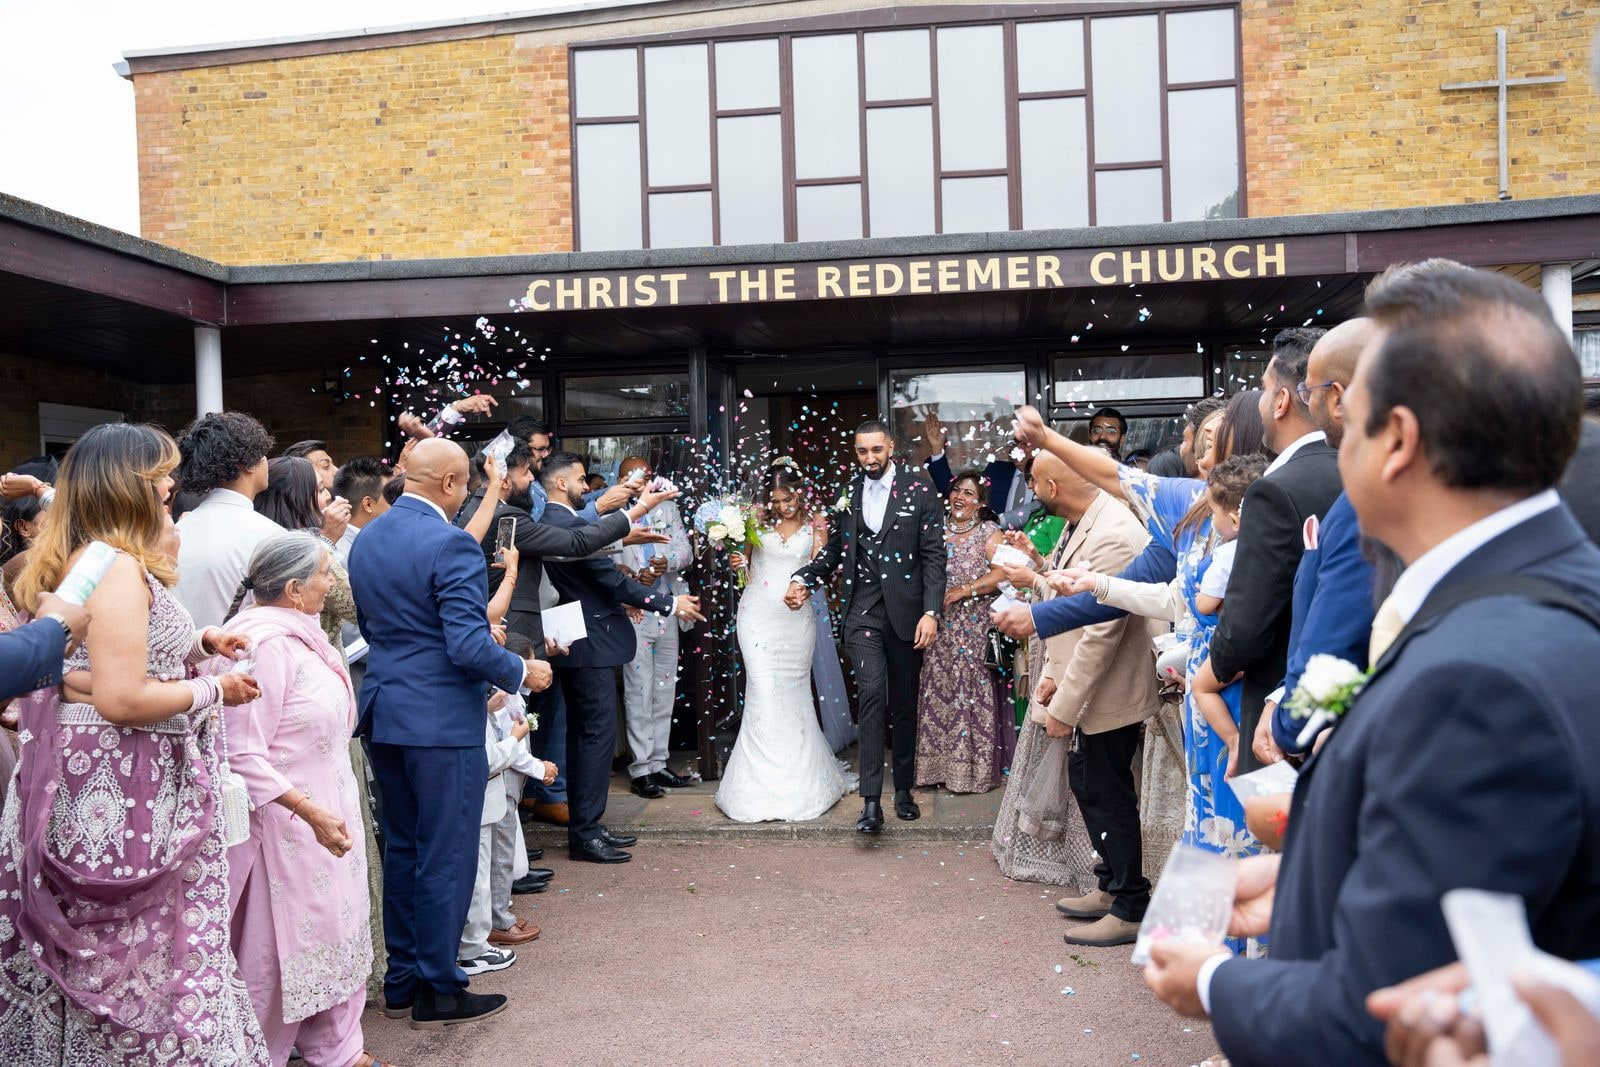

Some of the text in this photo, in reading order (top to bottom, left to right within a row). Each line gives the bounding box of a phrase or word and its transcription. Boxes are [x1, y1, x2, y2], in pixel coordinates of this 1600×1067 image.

[526, 242, 1286, 311] CHRIST THE REDEEMER CHURCH
